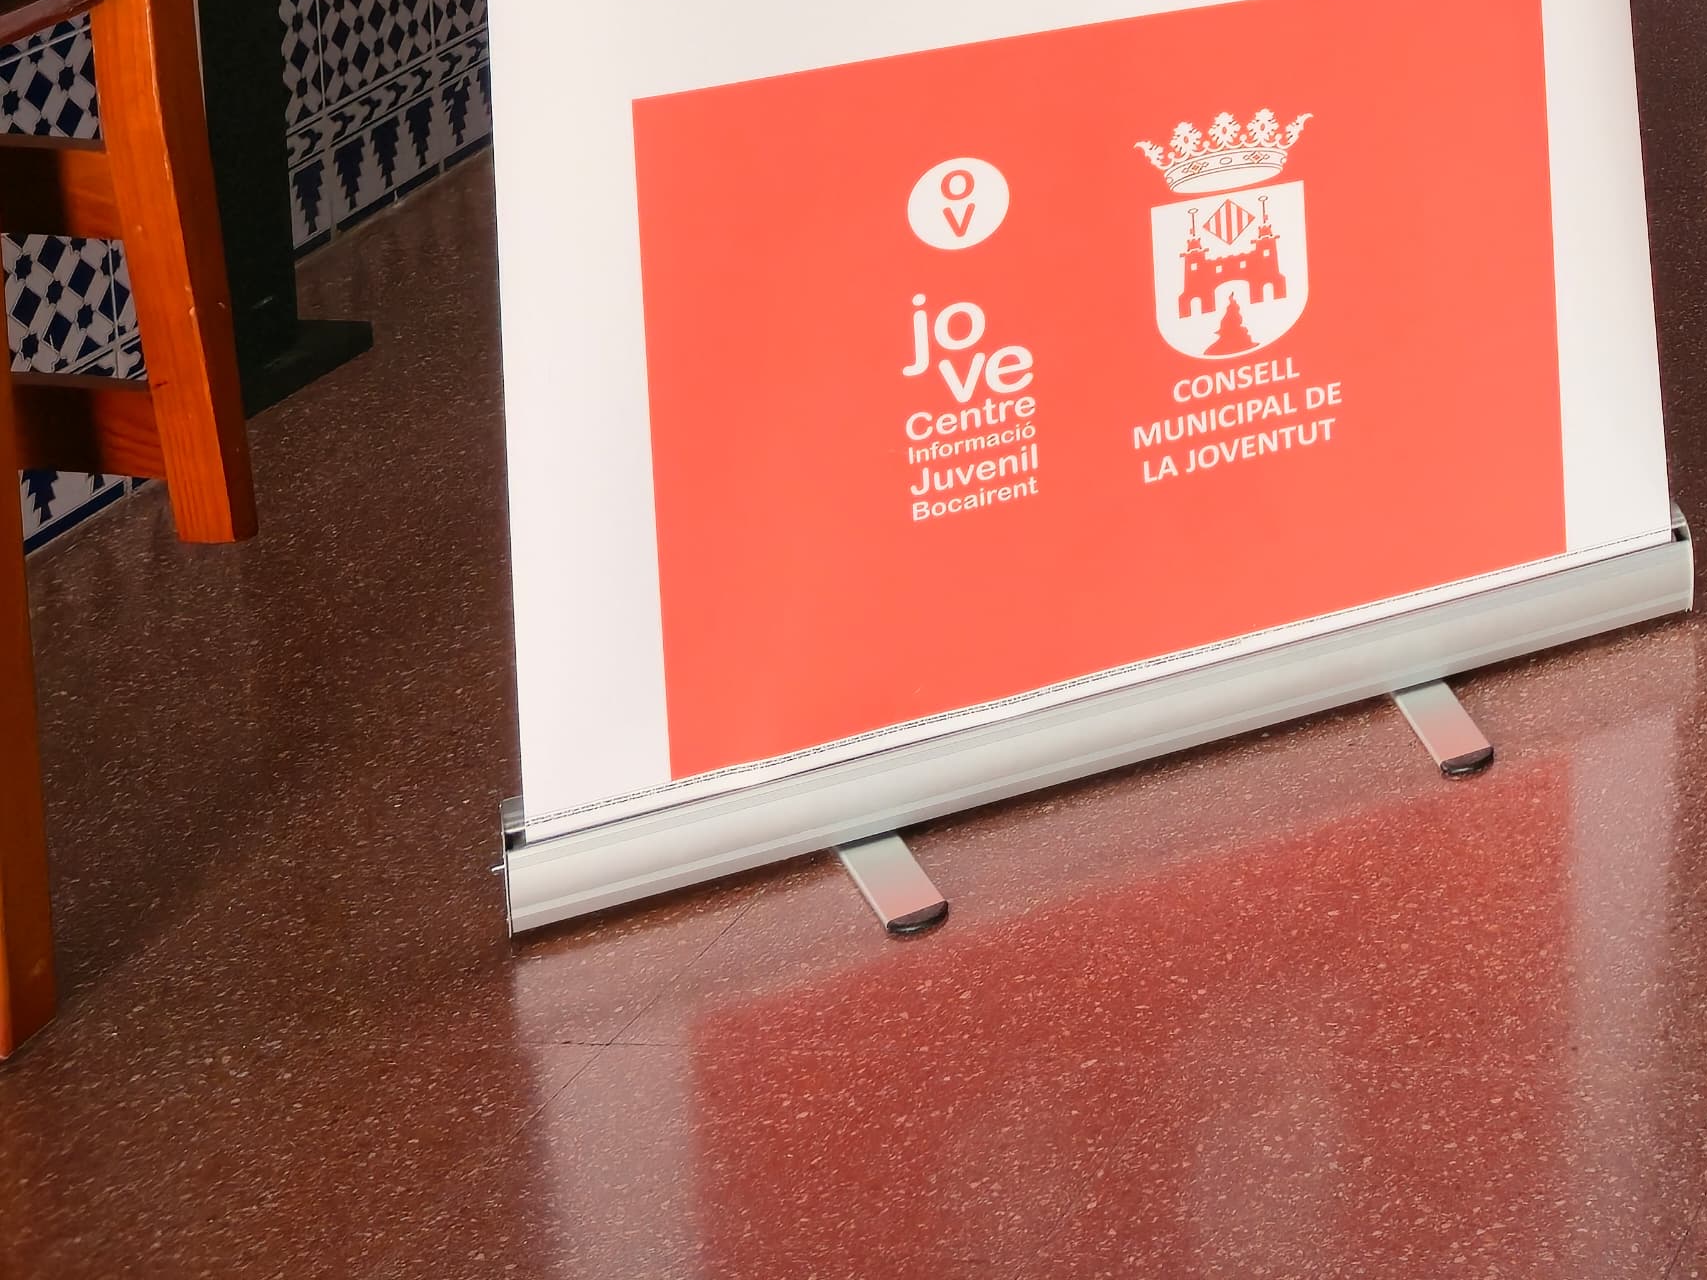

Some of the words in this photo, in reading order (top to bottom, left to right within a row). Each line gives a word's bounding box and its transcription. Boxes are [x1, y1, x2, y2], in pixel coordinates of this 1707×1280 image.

[1173, 357, 1300, 403] CONSELL
[905, 396, 1036, 441] Centre
[1133, 392, 1297, 450] MUNICIPAL
[1305, 382, 1343, 410] DE
[908, 421, 1036, 465] Informació
[1143, 455, 1179, 484] LA
[1186, 418, 1336, 473] JOVENTUT
[910, 443, 1039, 496] Juvenil
[911, 476, 1039, 522] Bocairent
